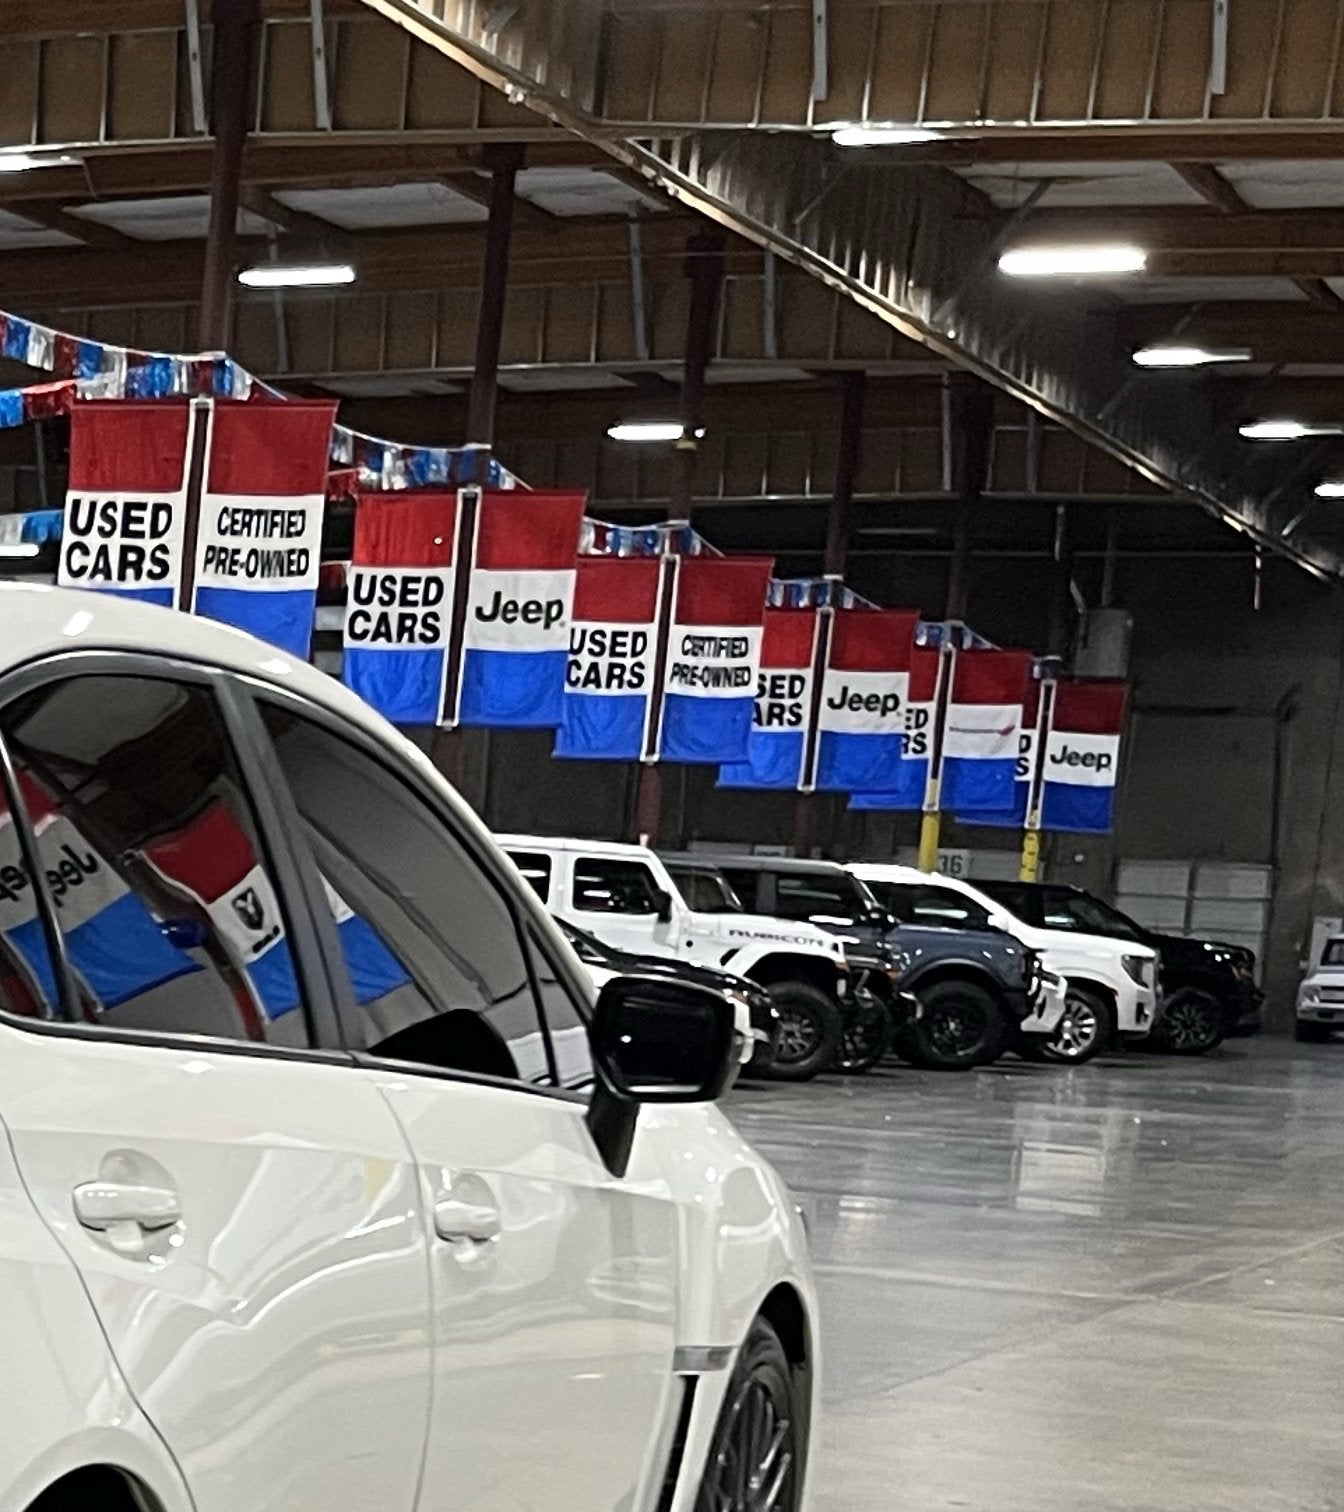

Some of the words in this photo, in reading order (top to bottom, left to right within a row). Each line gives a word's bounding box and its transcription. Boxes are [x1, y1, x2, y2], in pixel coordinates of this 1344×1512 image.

[69, 499, 173, 540] USED
[217, 507, 306, 539] CERTIFIED
[66, 541, 170, 582] CARS
[203, 545, 310, 579] PRE-OWNED
[353, 573, 444, 608] USED
[475, 591, 564, 629] Jeep
[348, 609, 441, 645] CARS
[570, 627, 648, 659] USED
[566, 659, 646, 690] CARS
[757, 673, 806, 700] SED
[753, 702, 803, 727] ARS
[827, 686, 900, 718] Jeep
[1050, 746, 1111, 773] Jeep
